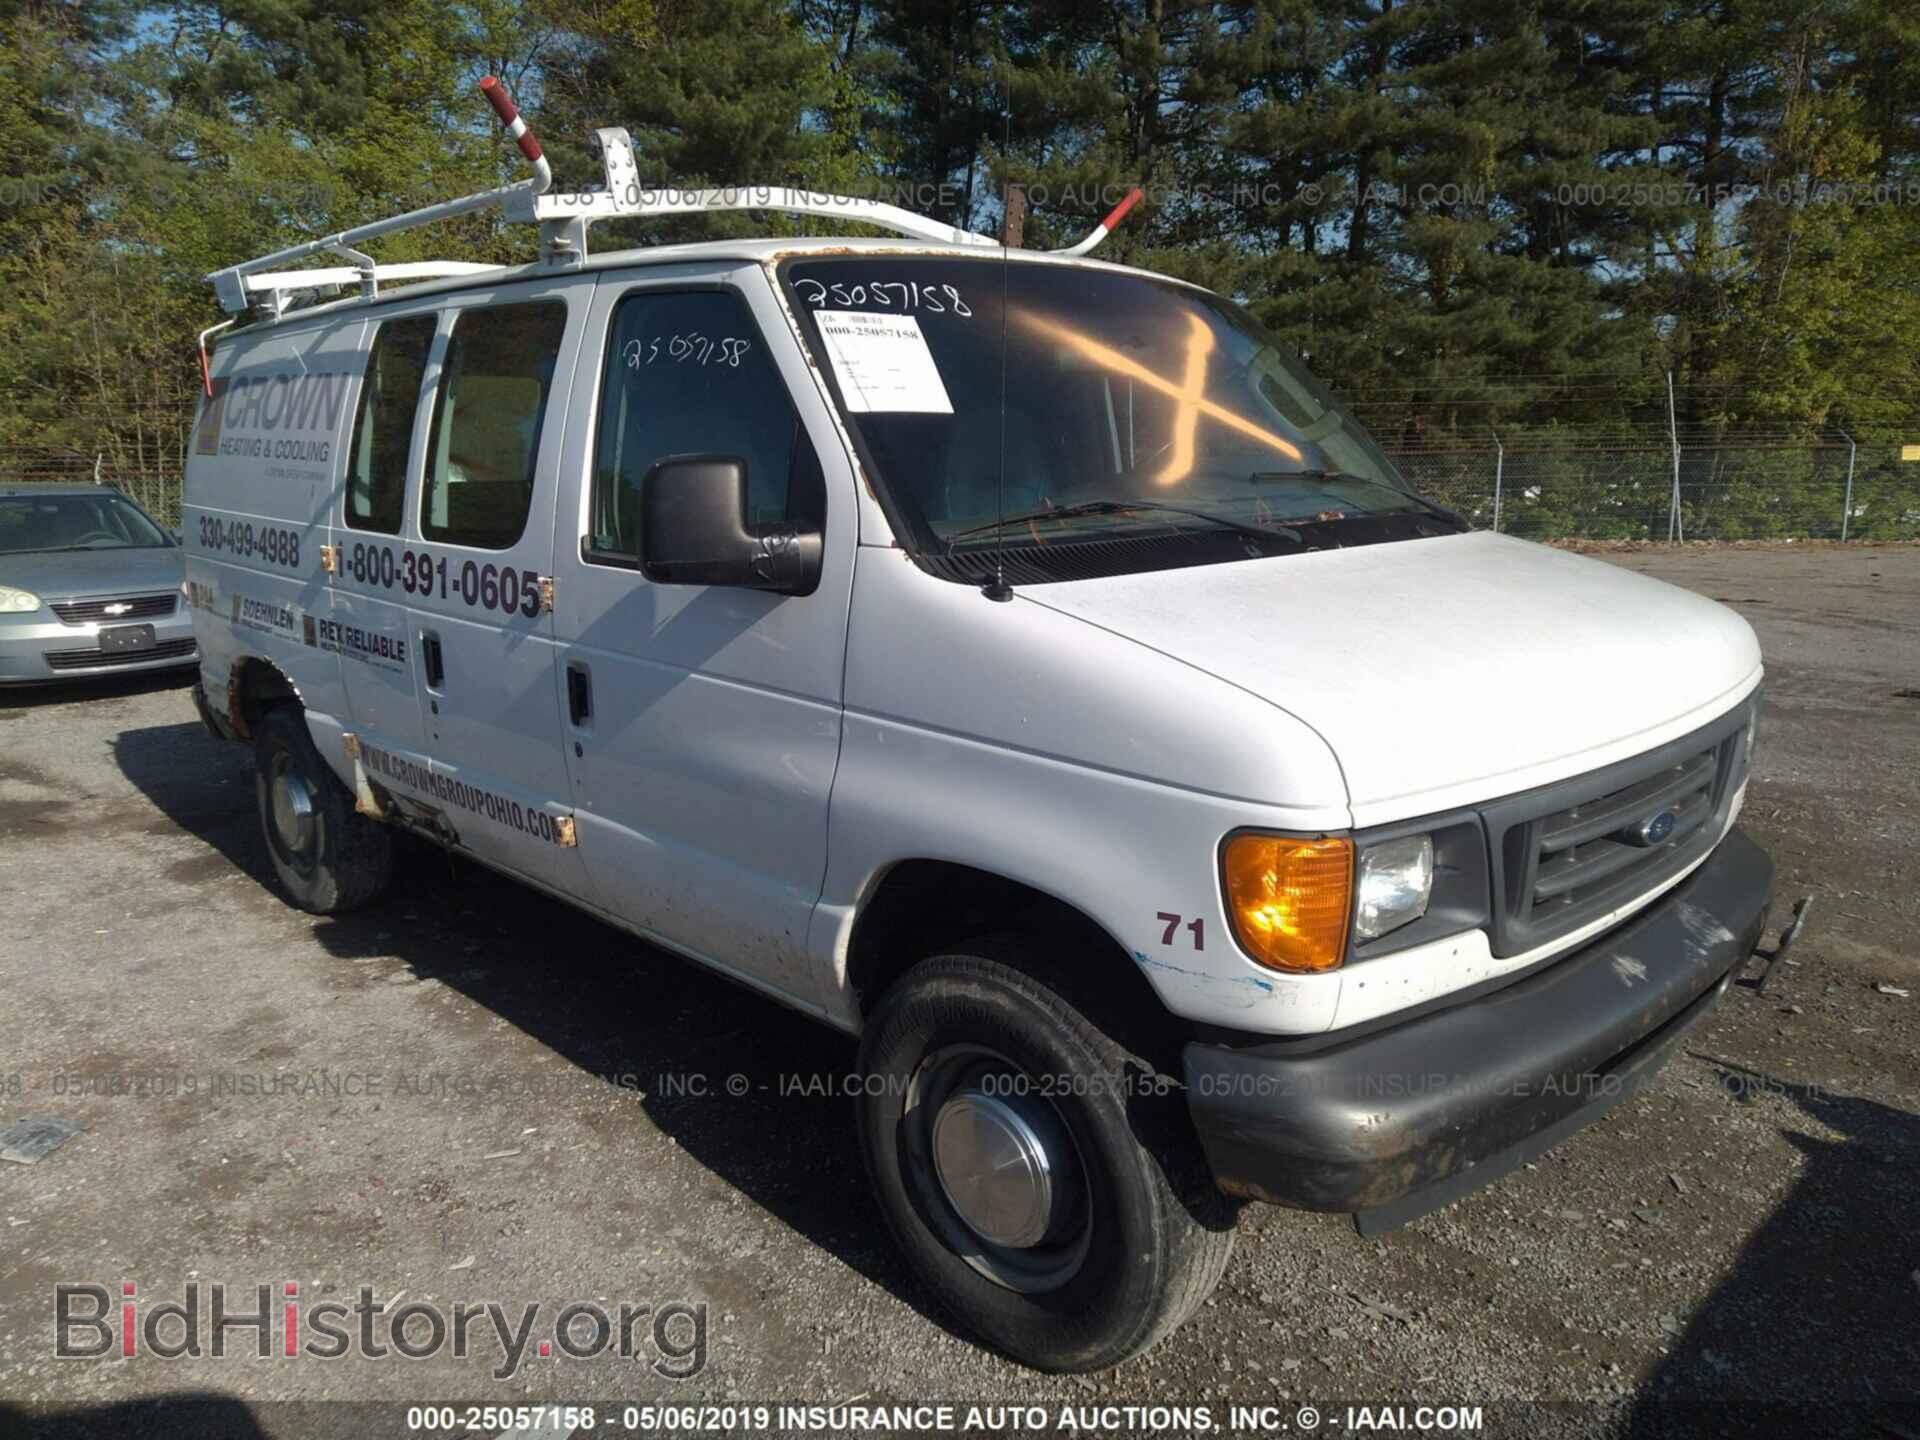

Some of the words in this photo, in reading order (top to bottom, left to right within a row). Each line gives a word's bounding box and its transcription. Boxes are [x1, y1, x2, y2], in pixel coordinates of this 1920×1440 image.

[793, 279, 972, 317] 25057158
[623, 332, 751, 371] 25057158
[824, 327, 918, 339] 000-25057158
[224, 373, 351, 430] CROWN
[220, 437, 261, 457] HEATING
[263, 440, 272, 458] &
[275, 440, 330, 462] COOLING
[200, 515, 300, 567] 330-499-4988
[336, 541, 540, 618] 1-800-391-0605
[243, 597, 294, 631] SOEHNLEN
[345, 626, 406, 663] RELIABLE
[1156, 911, 1204, 952] 71
